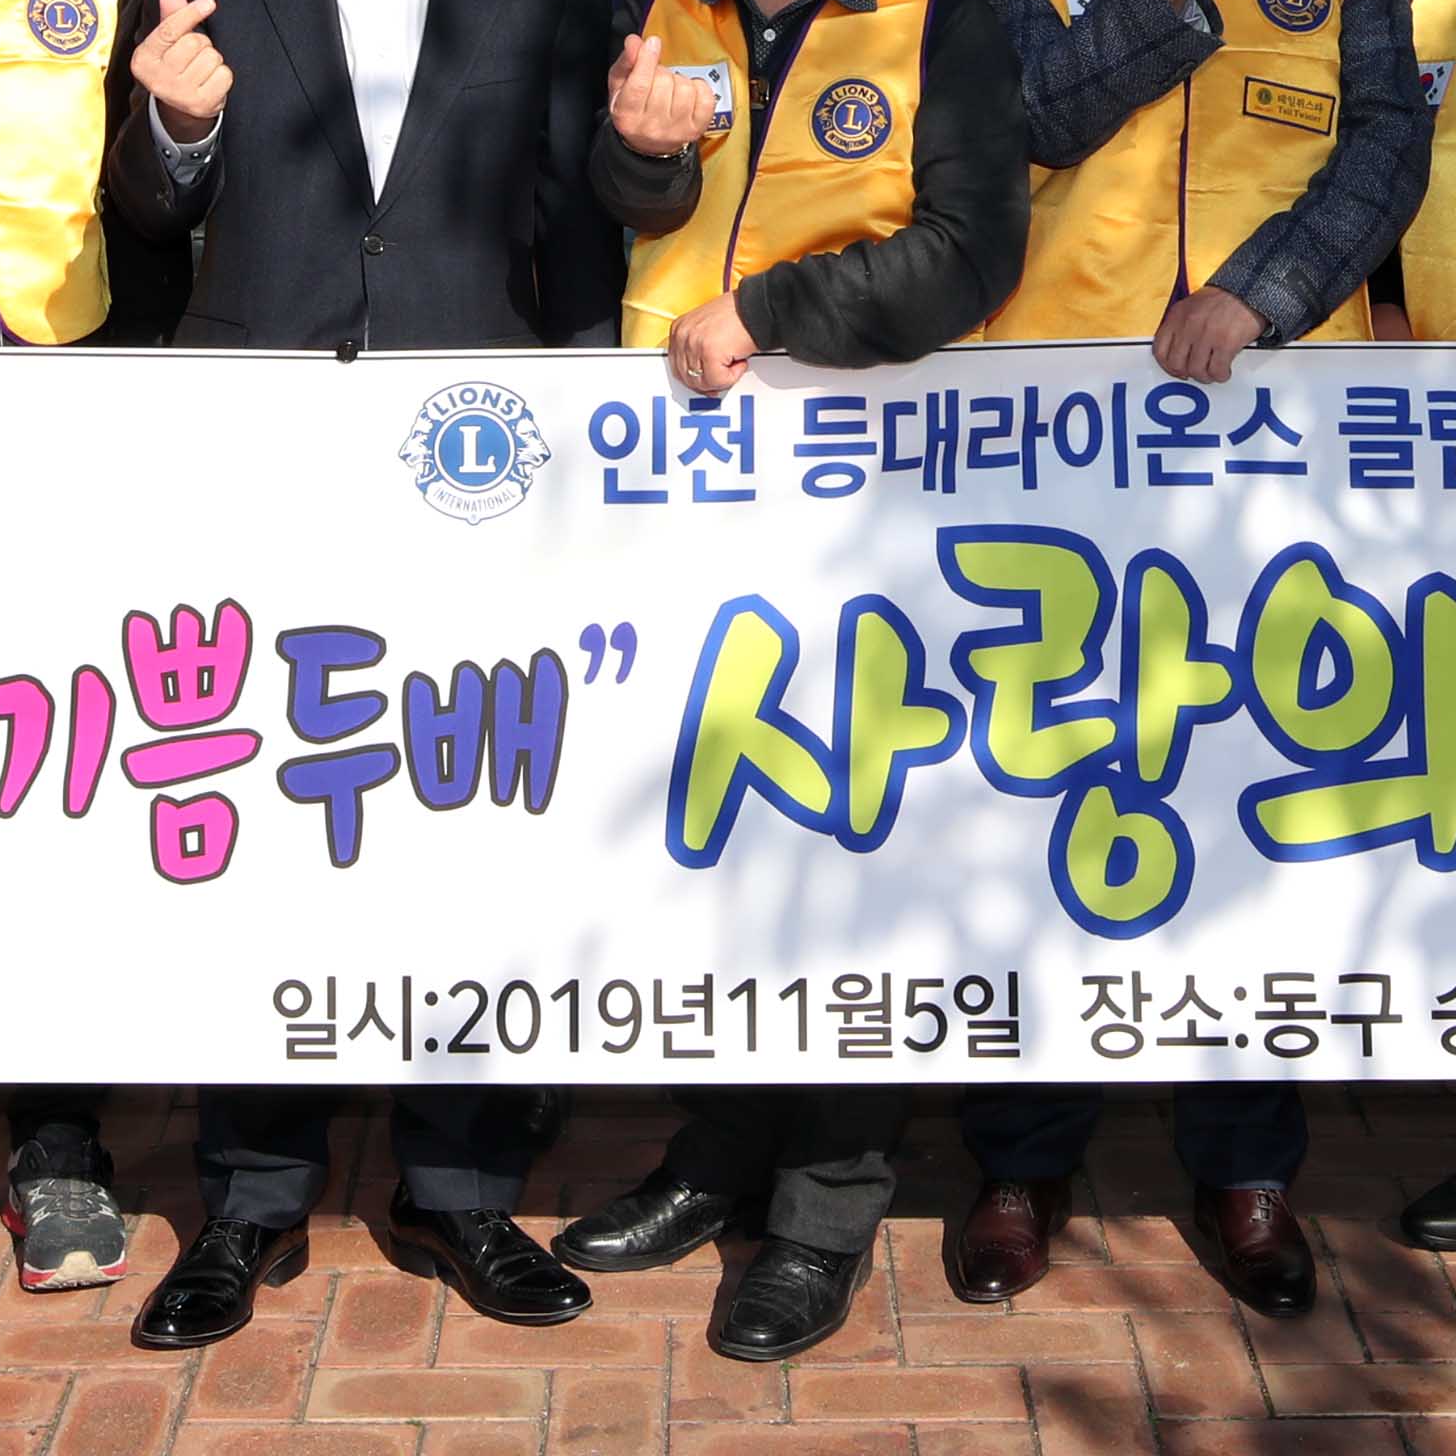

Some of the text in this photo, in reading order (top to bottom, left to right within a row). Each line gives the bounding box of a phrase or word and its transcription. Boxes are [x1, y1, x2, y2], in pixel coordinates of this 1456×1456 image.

[54, 5, 74, 28] L
[834, 86, 876, 102] LIONS
[842, 104, 862, 131] L
[432, 387, 517, 416] LIONS
[458, 425, 496, 473] L
[588, 394, 756, 504] 인천
[794, 382, 1309, 499] 등대라이온스
[433, 487, 517, 513] INTERNATIONAL
[273, 970, 1022, 1061] 일시:2019년11월5일
[1080, 970, 1403, 1059] 장소:동구
